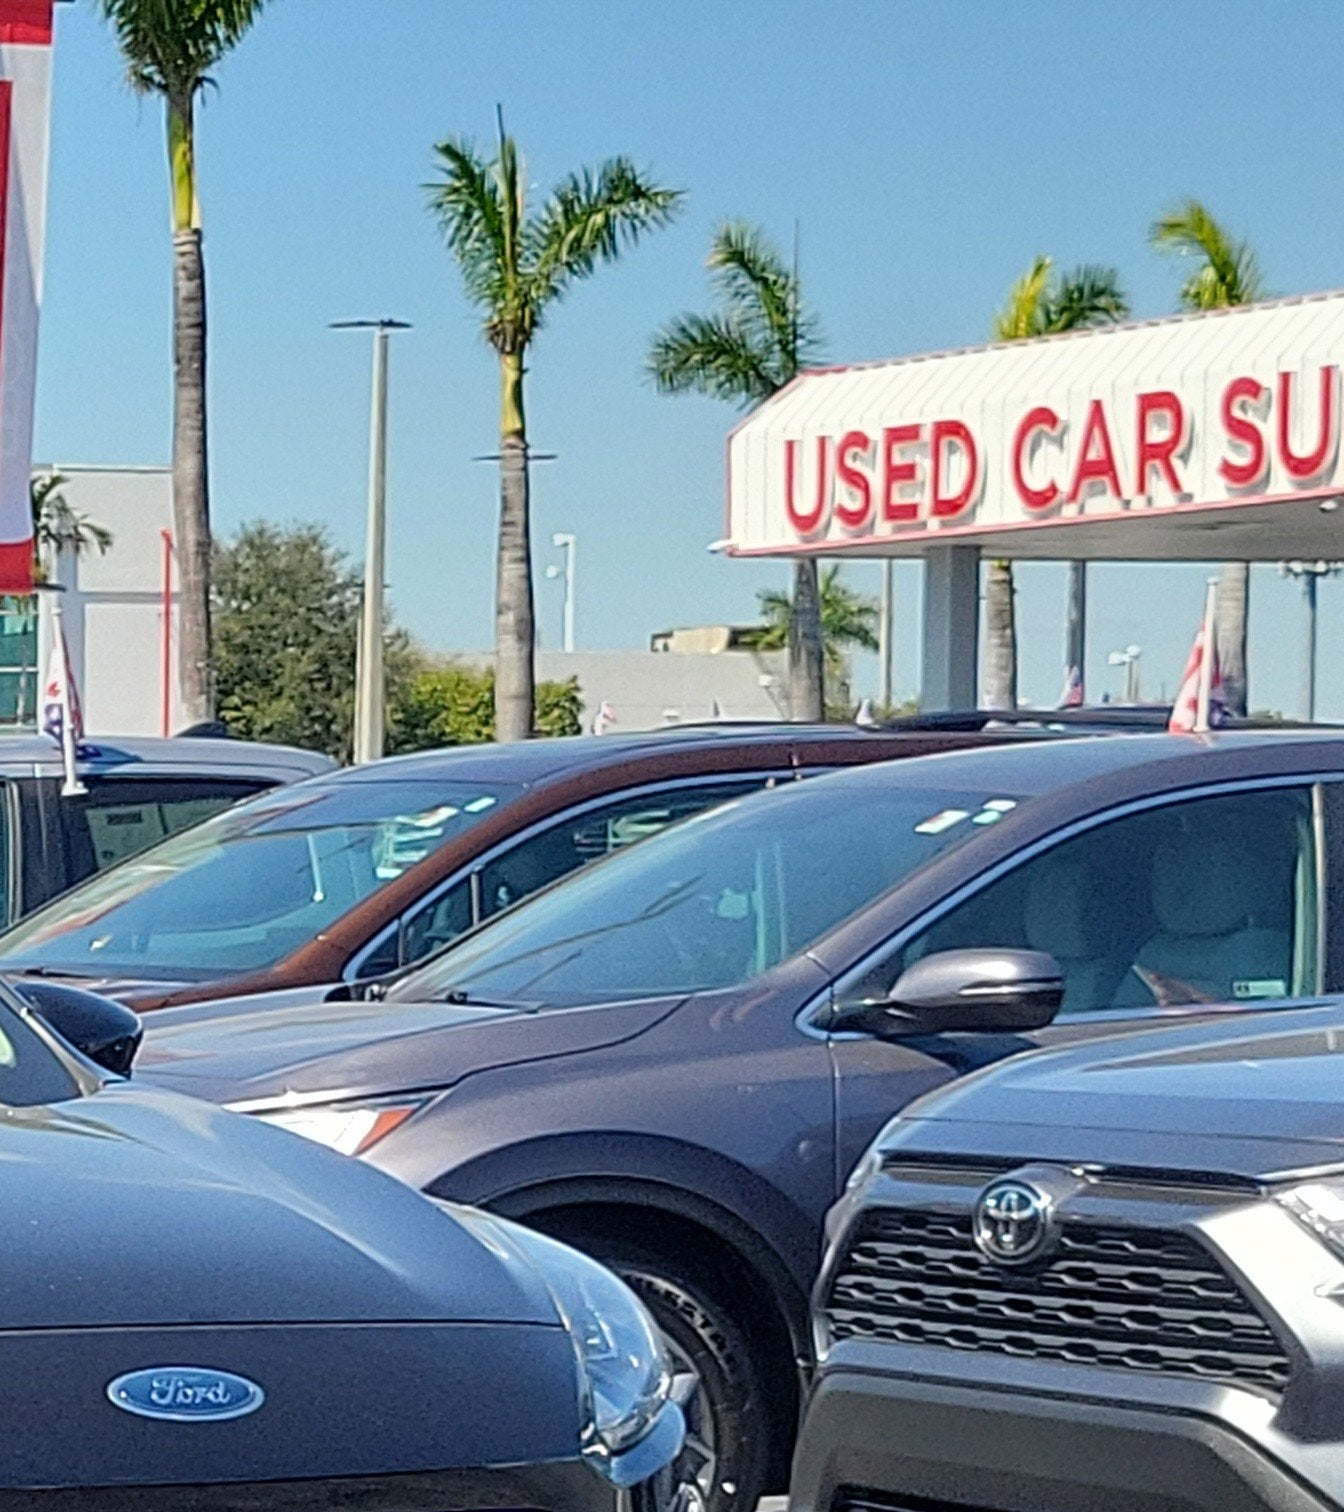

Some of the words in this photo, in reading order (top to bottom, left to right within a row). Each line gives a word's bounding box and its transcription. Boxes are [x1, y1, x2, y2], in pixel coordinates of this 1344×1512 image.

[784, 418, 978, 534] USED
[1013, 390, 1185, 510] CAR
[1218, 364, 1341, 489] SU
[150, 1375, 231, 1405] Ford
